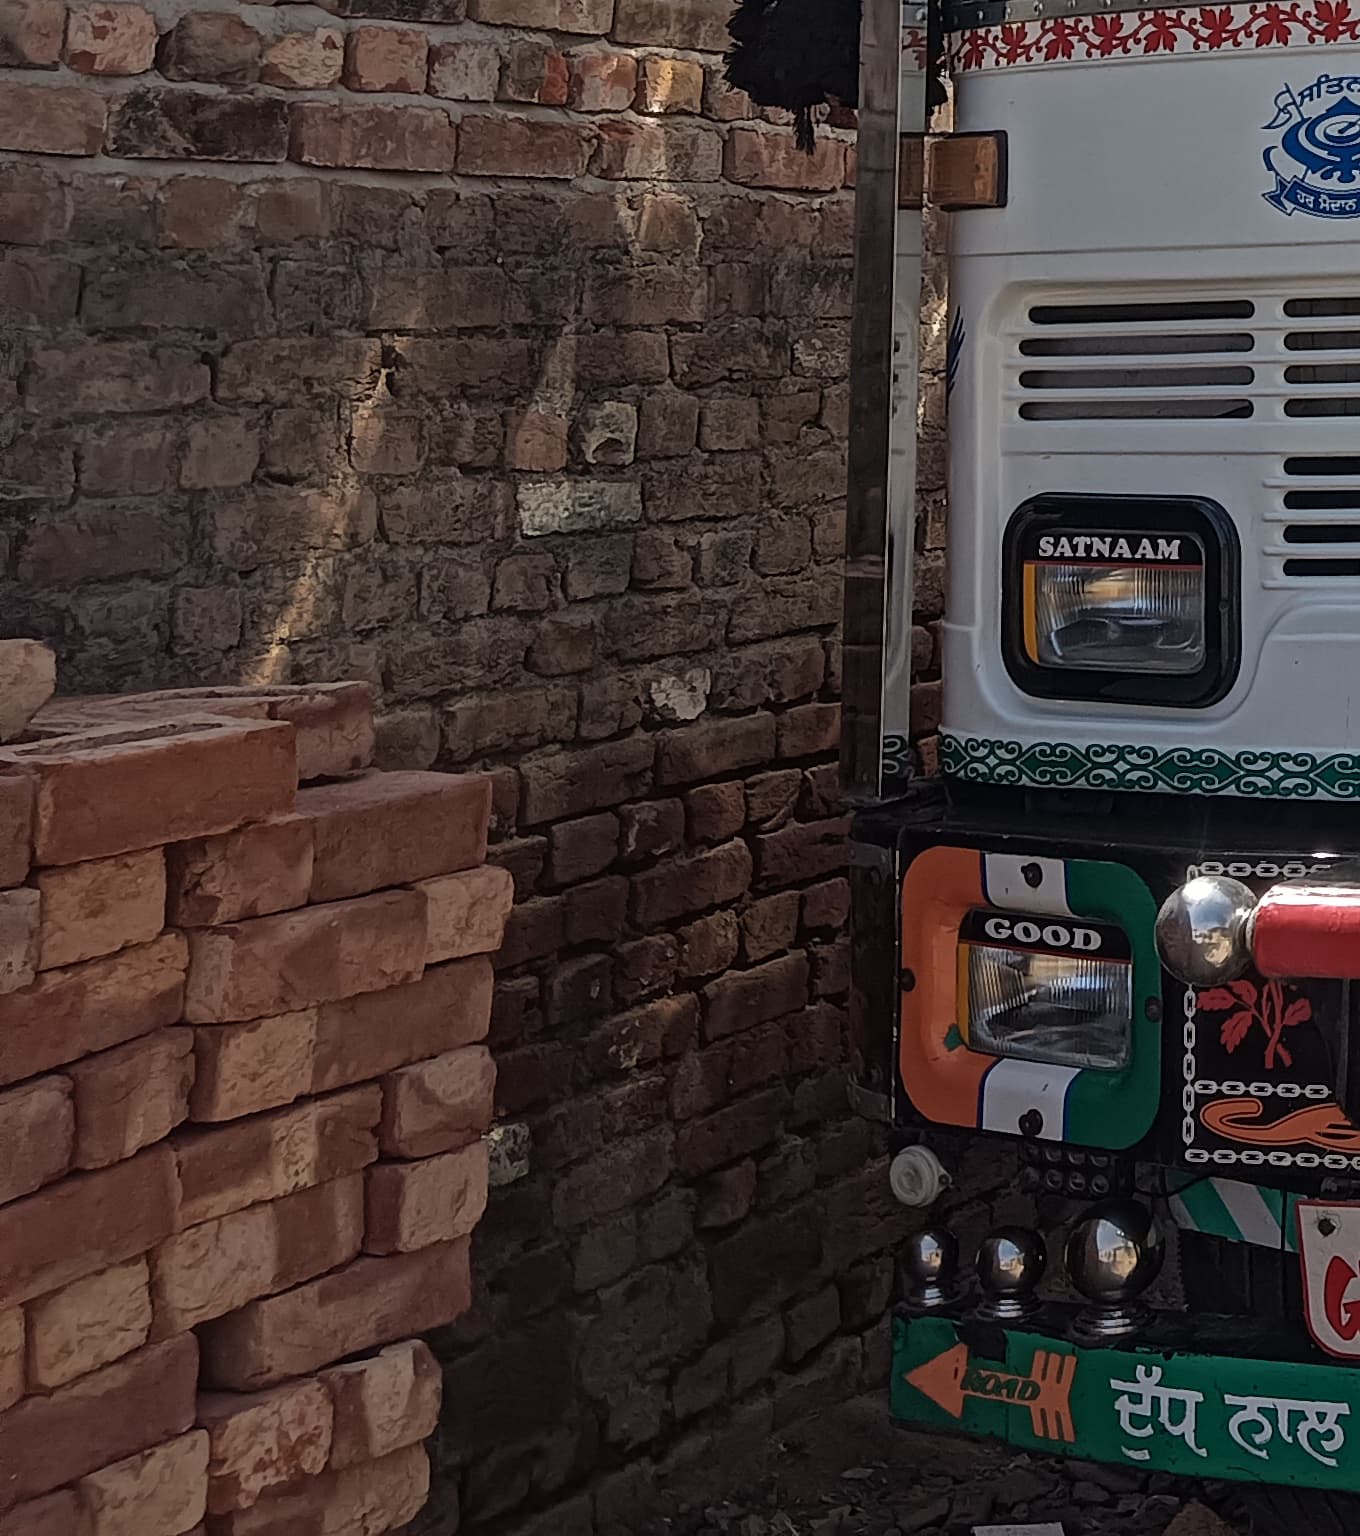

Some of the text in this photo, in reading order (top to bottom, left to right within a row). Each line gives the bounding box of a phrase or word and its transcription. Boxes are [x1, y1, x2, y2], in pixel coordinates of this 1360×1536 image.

[1038, 536, 1181, 560] SATNAAM
[984, 918, 1102, 951] GOOD
[1109, 1364, 1208, 1462] ਦੁੱਧ
[1224, 1393, 1352, 1468] ਨਾਲ
